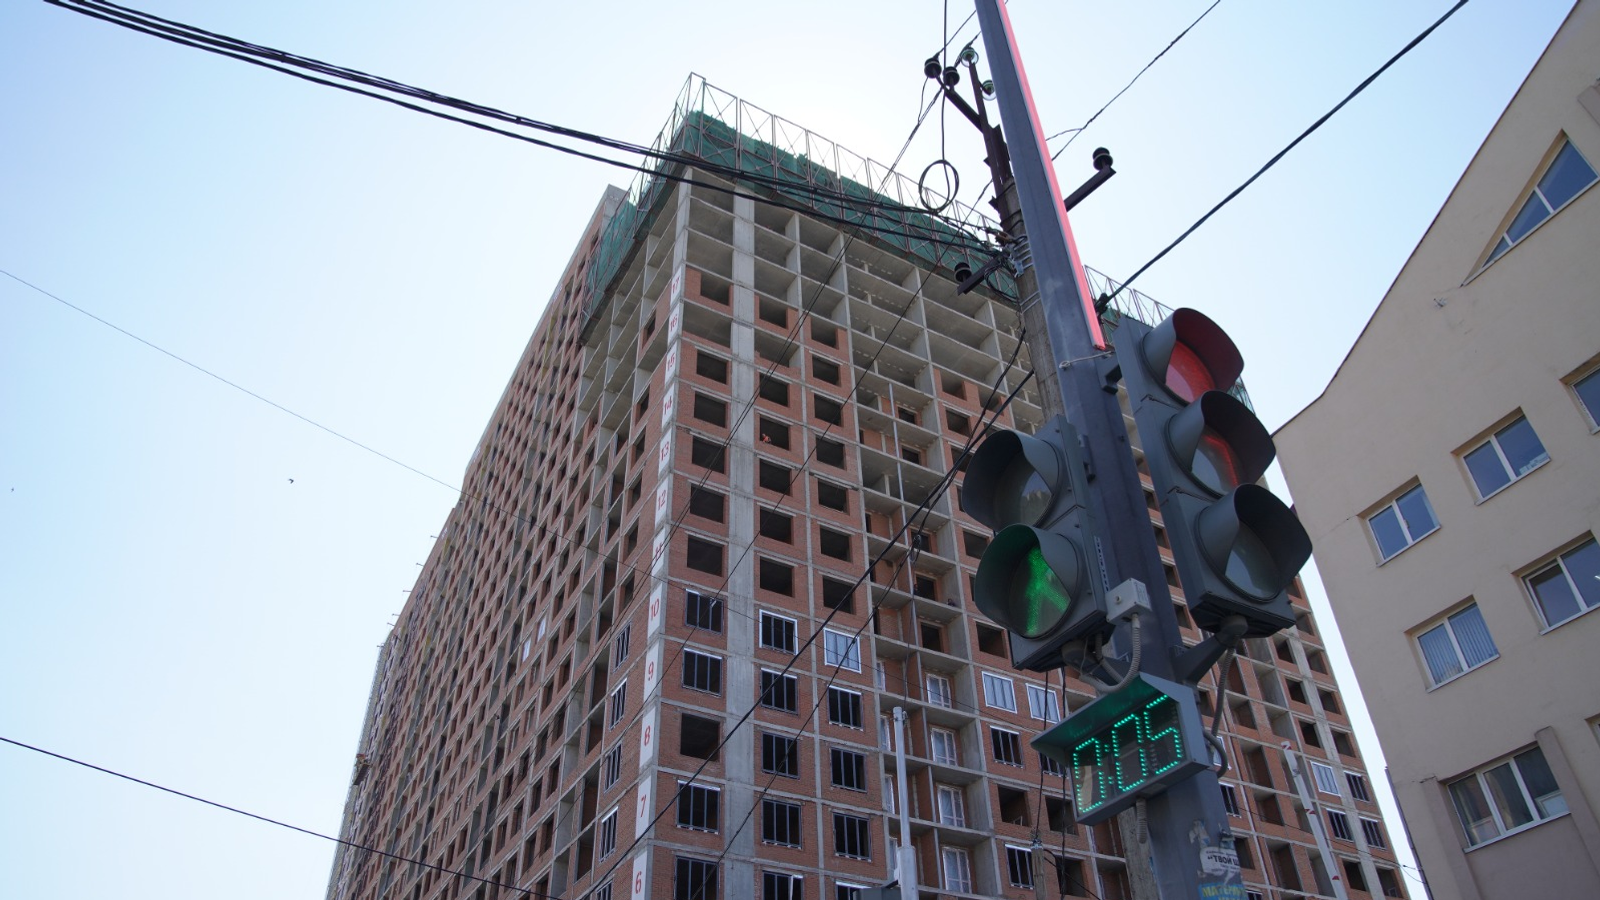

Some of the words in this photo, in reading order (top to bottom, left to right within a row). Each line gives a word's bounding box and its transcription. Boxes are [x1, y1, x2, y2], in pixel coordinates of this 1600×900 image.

[672, 277, 680, 294] 17
[669, 314, 678, 332] 16
[667, 353, 675, 370] 15
[664, 395, 672, 415] 14
[661, 441, 669, 461] 13
[658, 489, 666, 511] 12
[651, 598, 660, 621] 10
[648, 661, 655, 681] 9
[644, 725, 651, 747] 8
[640, 794, 647, 818] 7
[635, 871, 642, 894] 6
